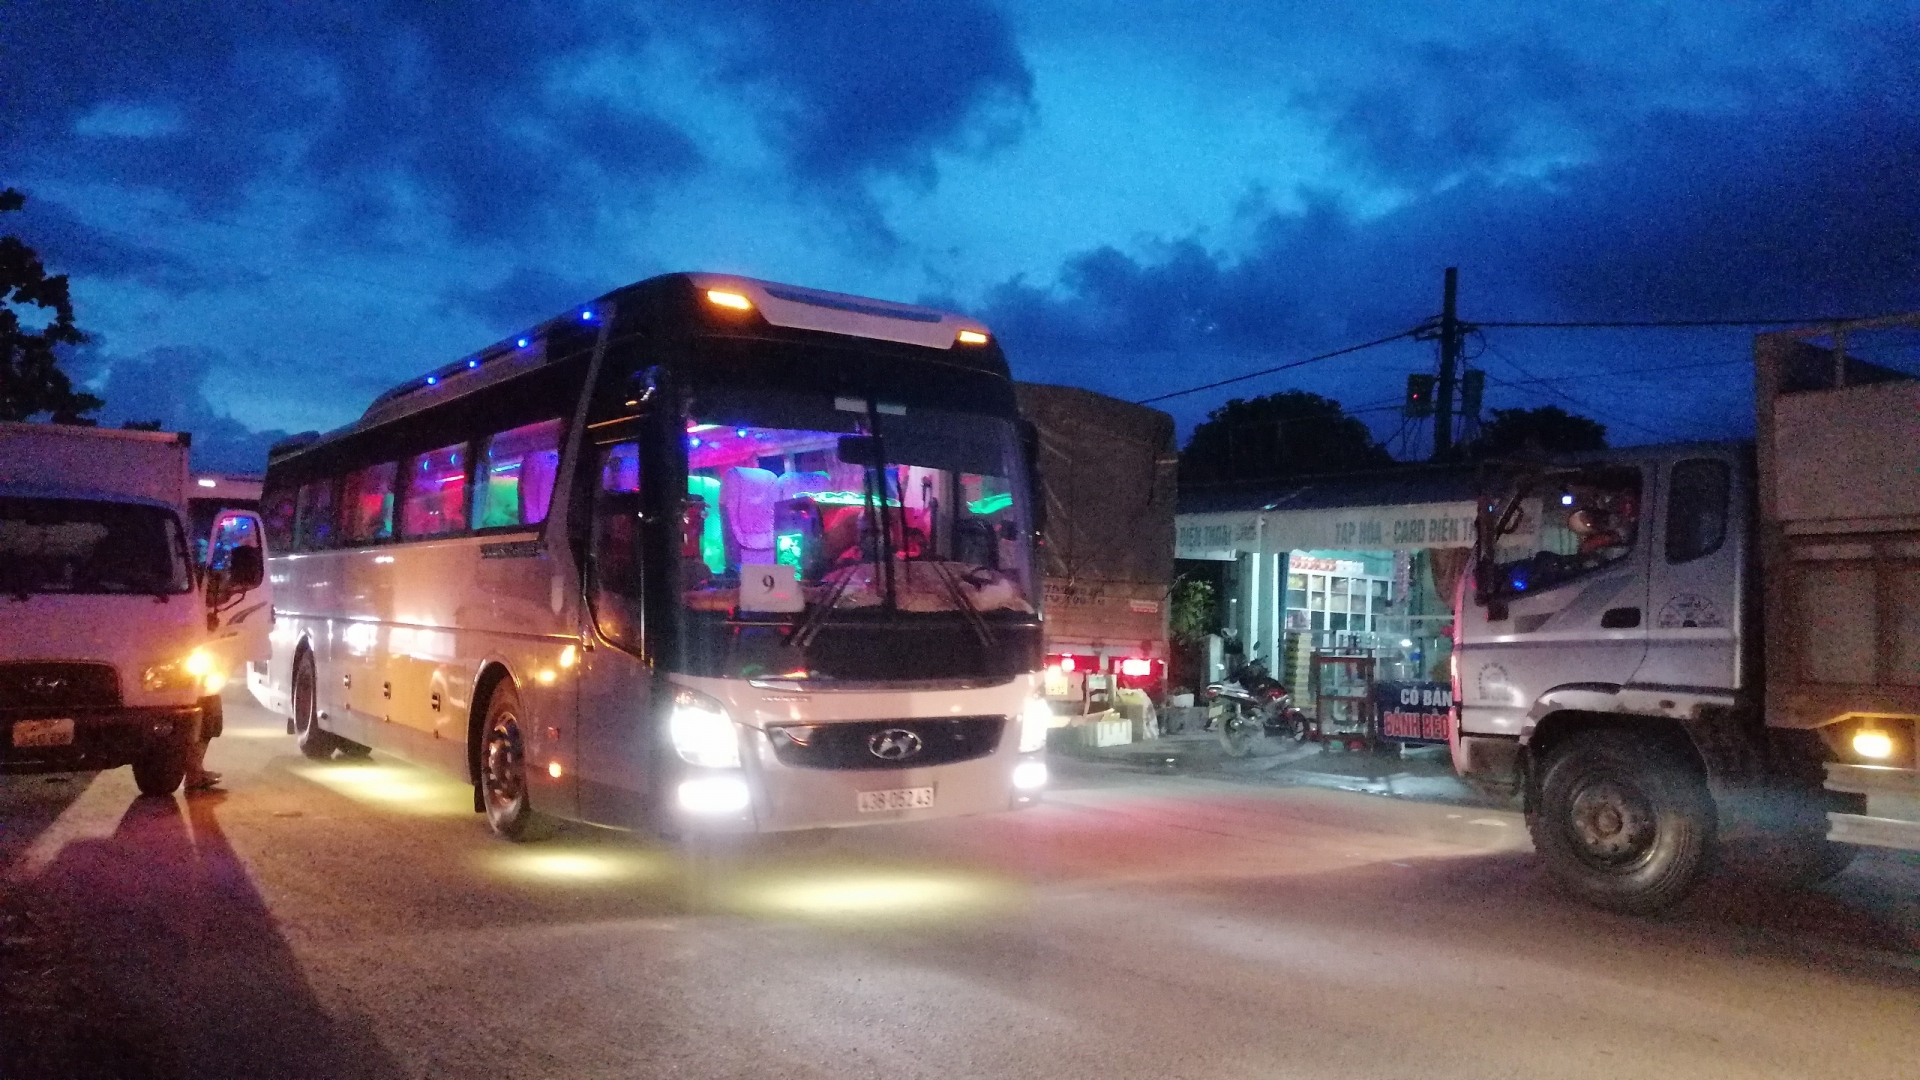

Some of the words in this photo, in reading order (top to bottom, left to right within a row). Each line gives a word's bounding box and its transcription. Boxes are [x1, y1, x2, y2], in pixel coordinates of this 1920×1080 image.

[1394, 518, 1426, 543] CARD
[762, 574, 775, 594] 9
[1400, 686, 1419, 705] CÓ
[1423, 686, 1453, 707] BÁN
[1384, 706, 1421, 738] BÁNH
